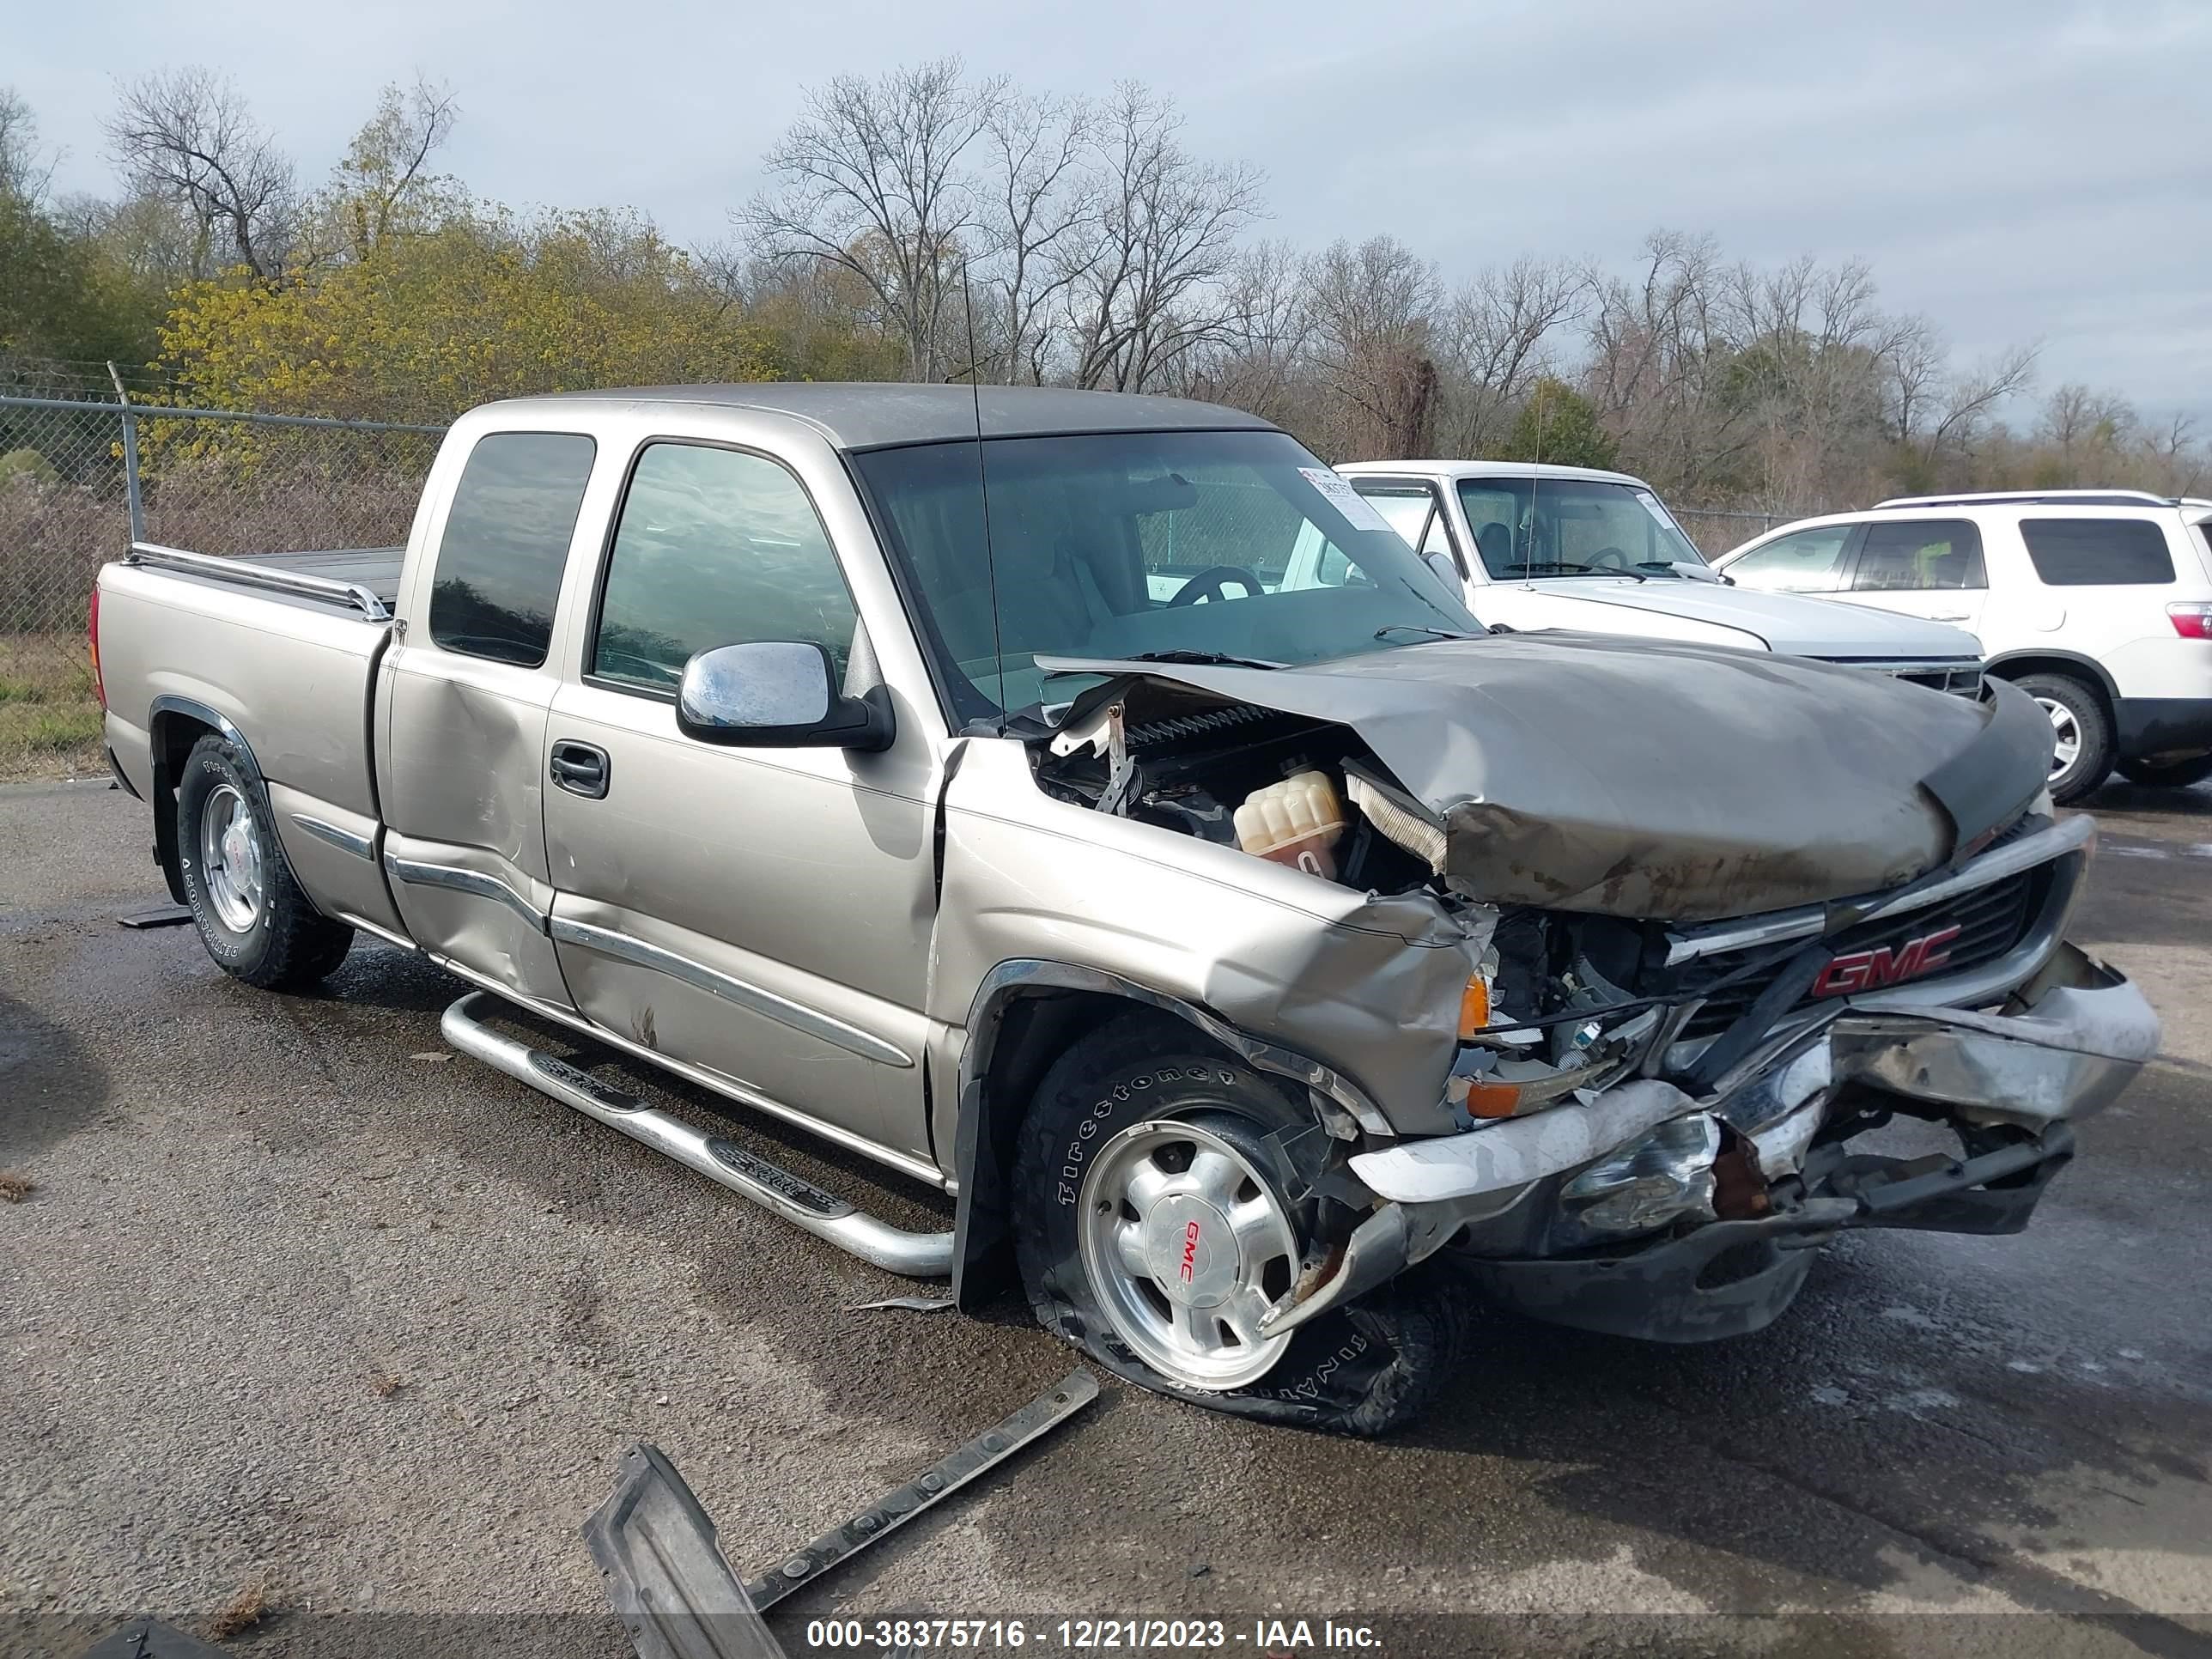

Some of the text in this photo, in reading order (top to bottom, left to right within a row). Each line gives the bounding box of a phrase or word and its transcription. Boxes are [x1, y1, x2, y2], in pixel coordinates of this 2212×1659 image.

[185, 874, 240, 957] DESTINATION
[1812, 923, 1962, 999] GMC
[1058, 1068, 1210, 1206] Firestone
[1179, 1221, 1200, 1285] GMC
